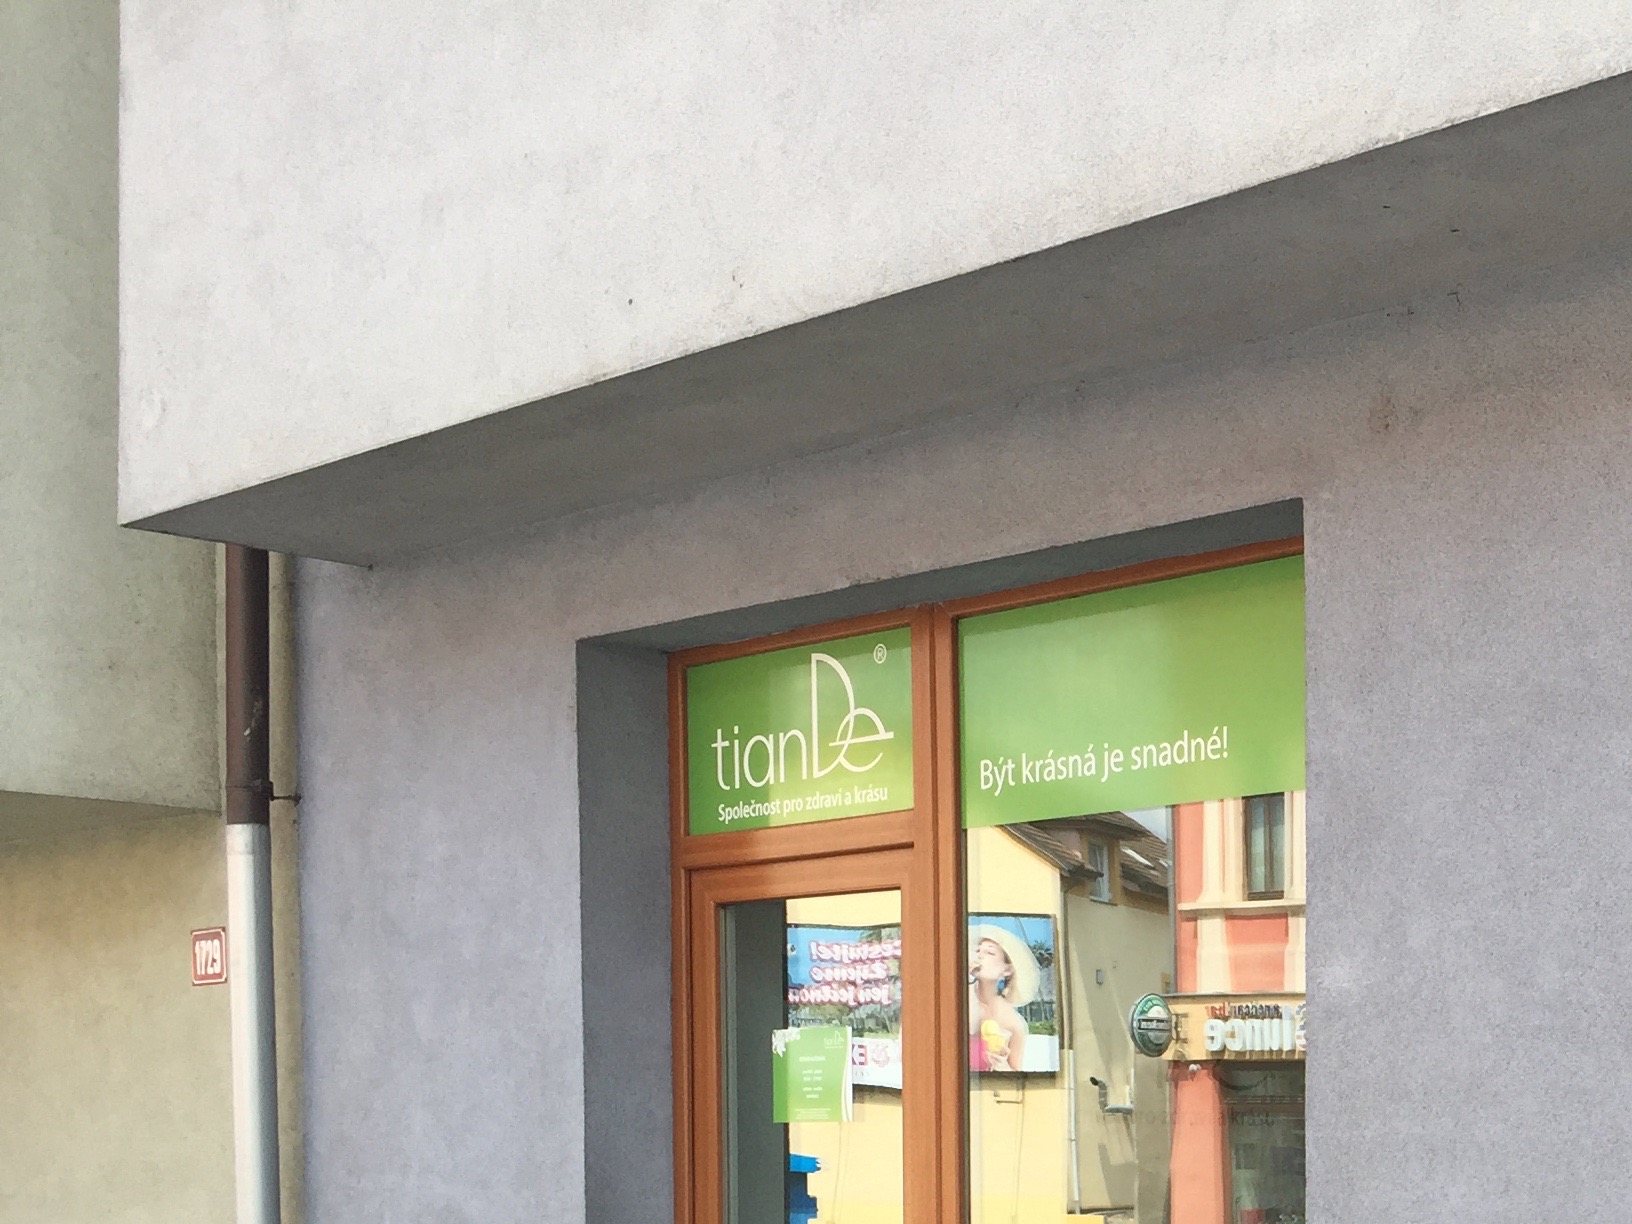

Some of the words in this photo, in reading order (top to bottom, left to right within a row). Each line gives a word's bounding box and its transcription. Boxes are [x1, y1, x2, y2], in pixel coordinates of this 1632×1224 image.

[711, 653, 894, 790] tianDe
[980, 757, 1015, 797] Být
[1022, 744, 1095, 784] krásná
[1101, 743, 1124, 782] je
[1131, 726, 1228, 771] snadné!
[718, 799, 780, 824] Společnost
[783, 799, 803, 816] pro
[844, 792, 851, 804] a
[855, 785, 888, 803] krásu
[195, 938, 221, 975] 1729
